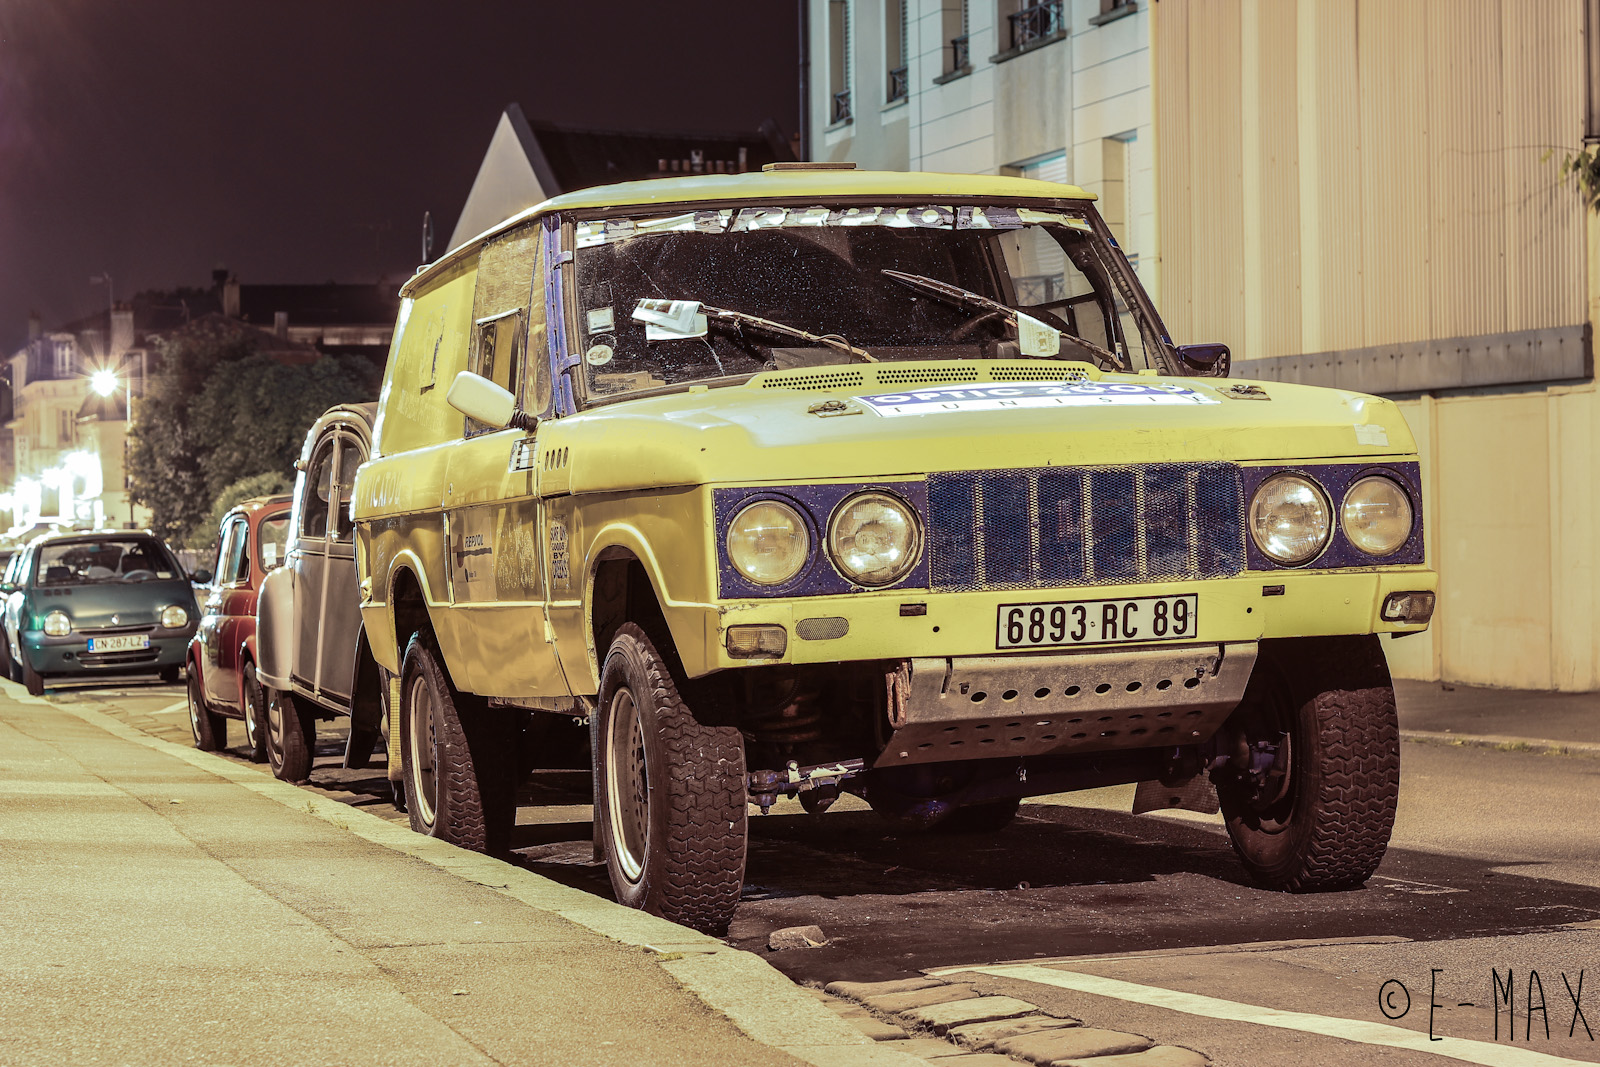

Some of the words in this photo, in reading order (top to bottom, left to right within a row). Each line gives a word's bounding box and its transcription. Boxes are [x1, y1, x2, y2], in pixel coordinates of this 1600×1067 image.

[873, 388, 1024, 403] OPTIC
[553, 552, 564, 560] BY
[1007, 605, 1087, 644] 6893
[1101, 602, 1139, 640] RC
[1152, 599, 1188, 637] 89
